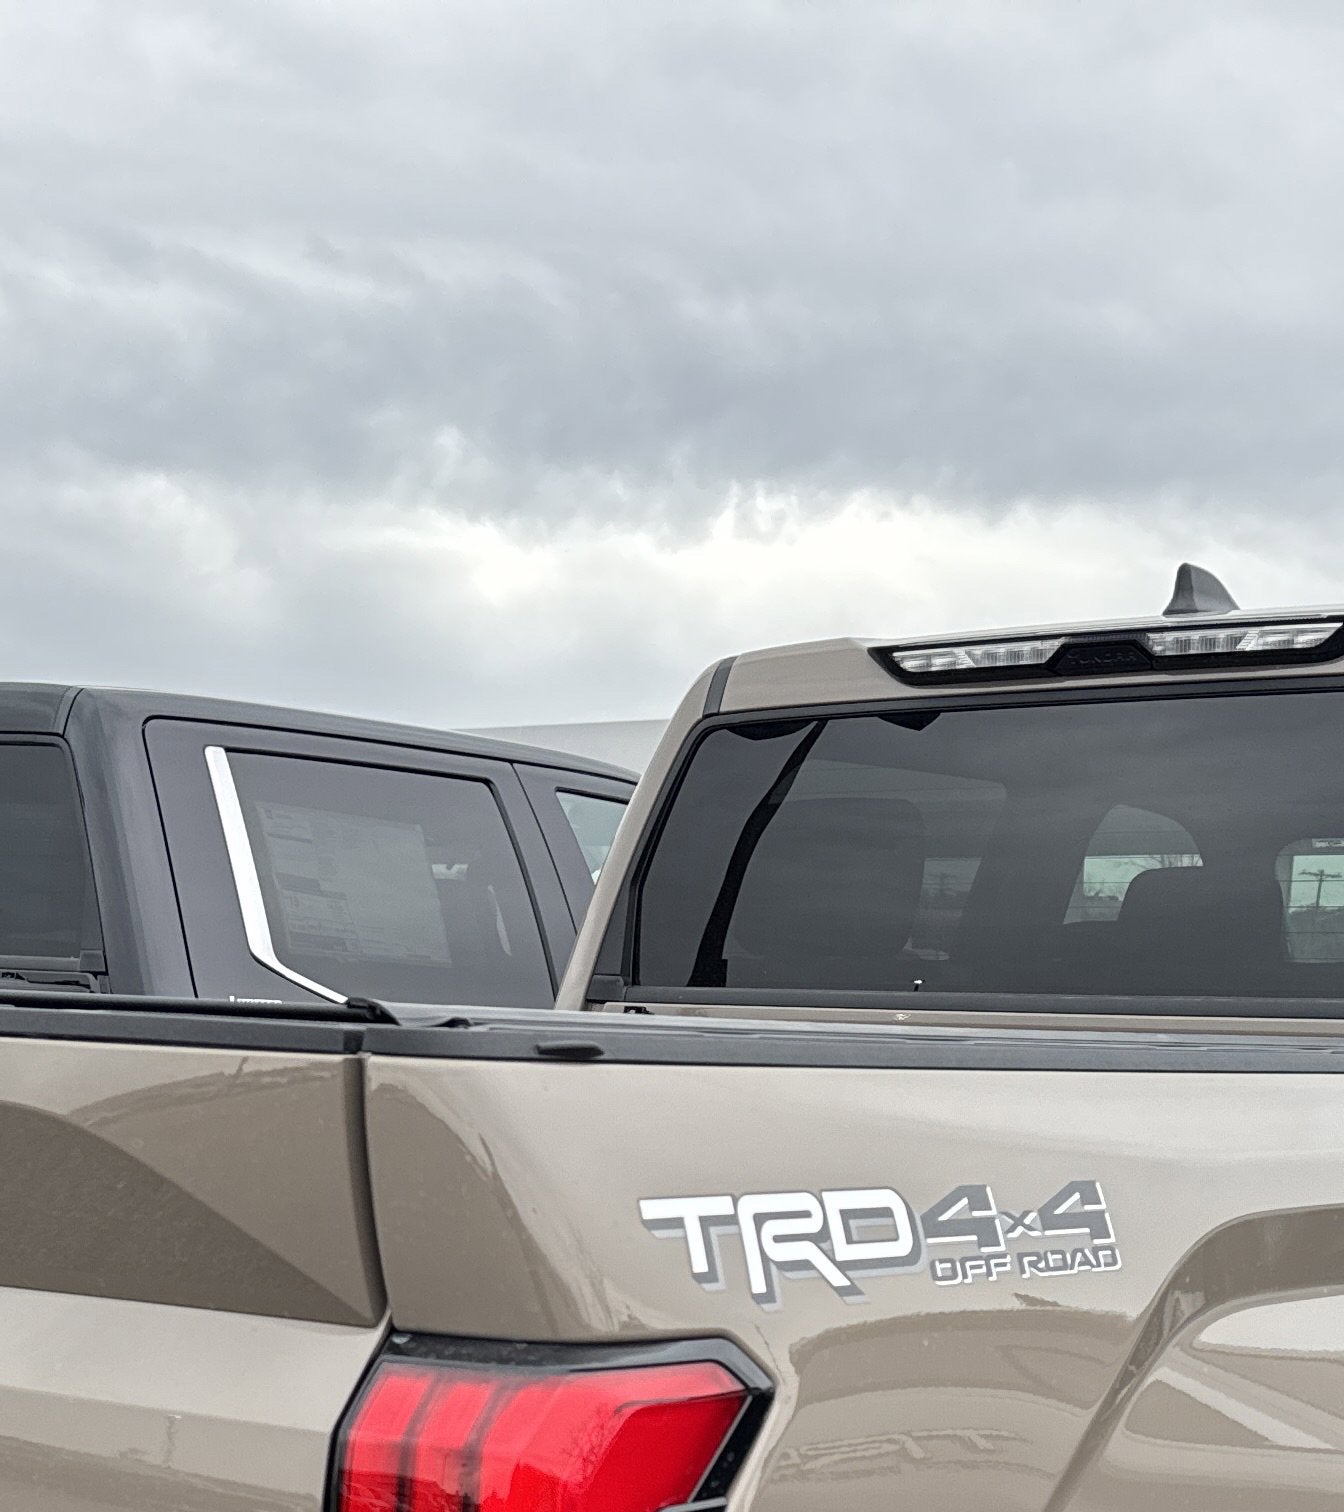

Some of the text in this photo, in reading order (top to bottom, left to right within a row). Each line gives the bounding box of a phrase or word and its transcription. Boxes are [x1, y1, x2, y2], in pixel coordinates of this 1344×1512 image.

[638, 1186, 925, 1311] TRD
[930, 1244, 1123, 1286] OFF ROAD
